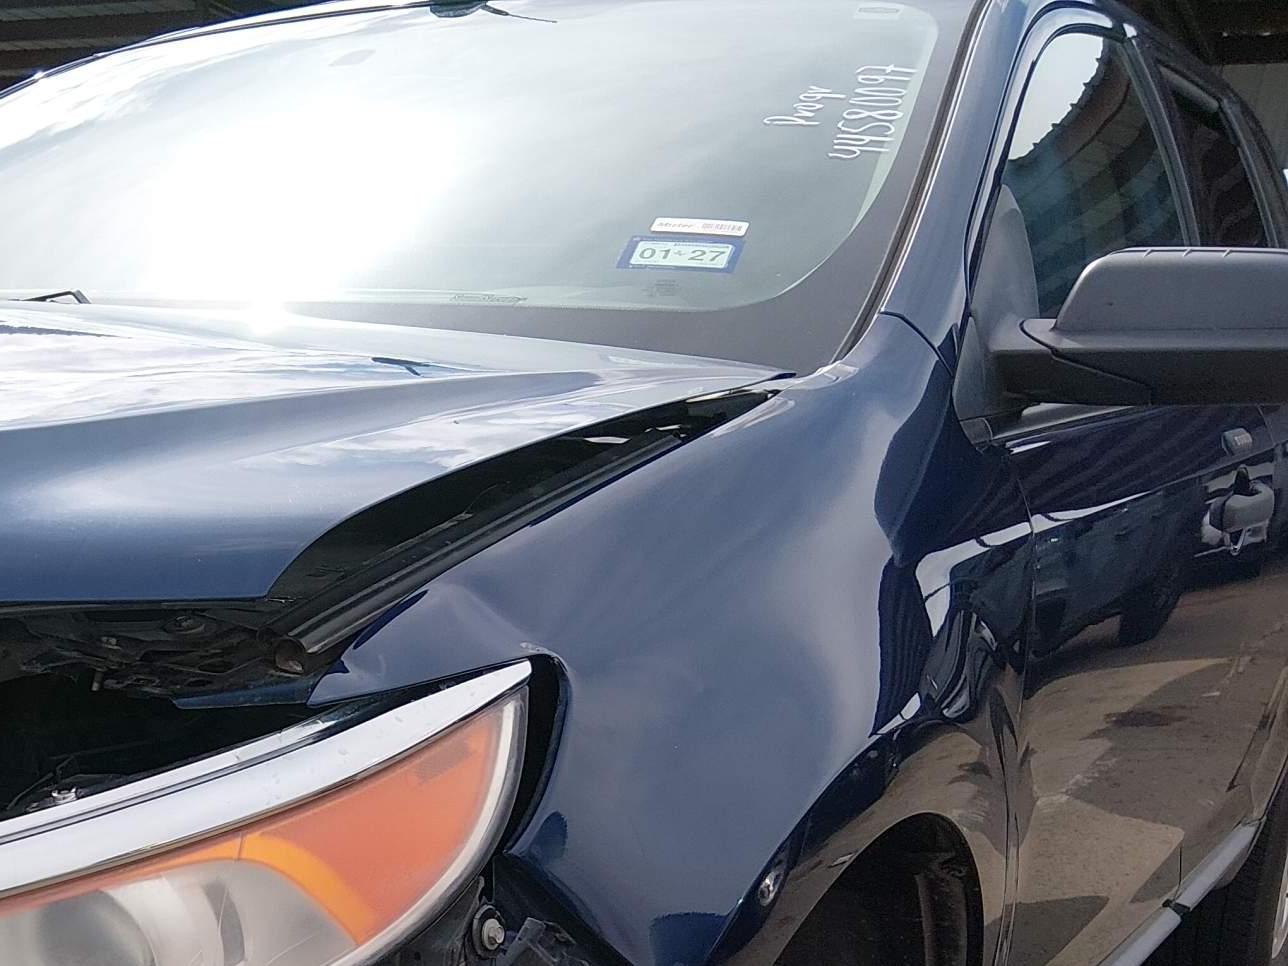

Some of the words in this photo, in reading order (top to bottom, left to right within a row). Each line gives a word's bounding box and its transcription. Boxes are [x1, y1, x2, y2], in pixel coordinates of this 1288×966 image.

[827, 64, 918, 159] 44580097
[638, 247, 672, 260] 01
[687, 249, 726, 262] 27
